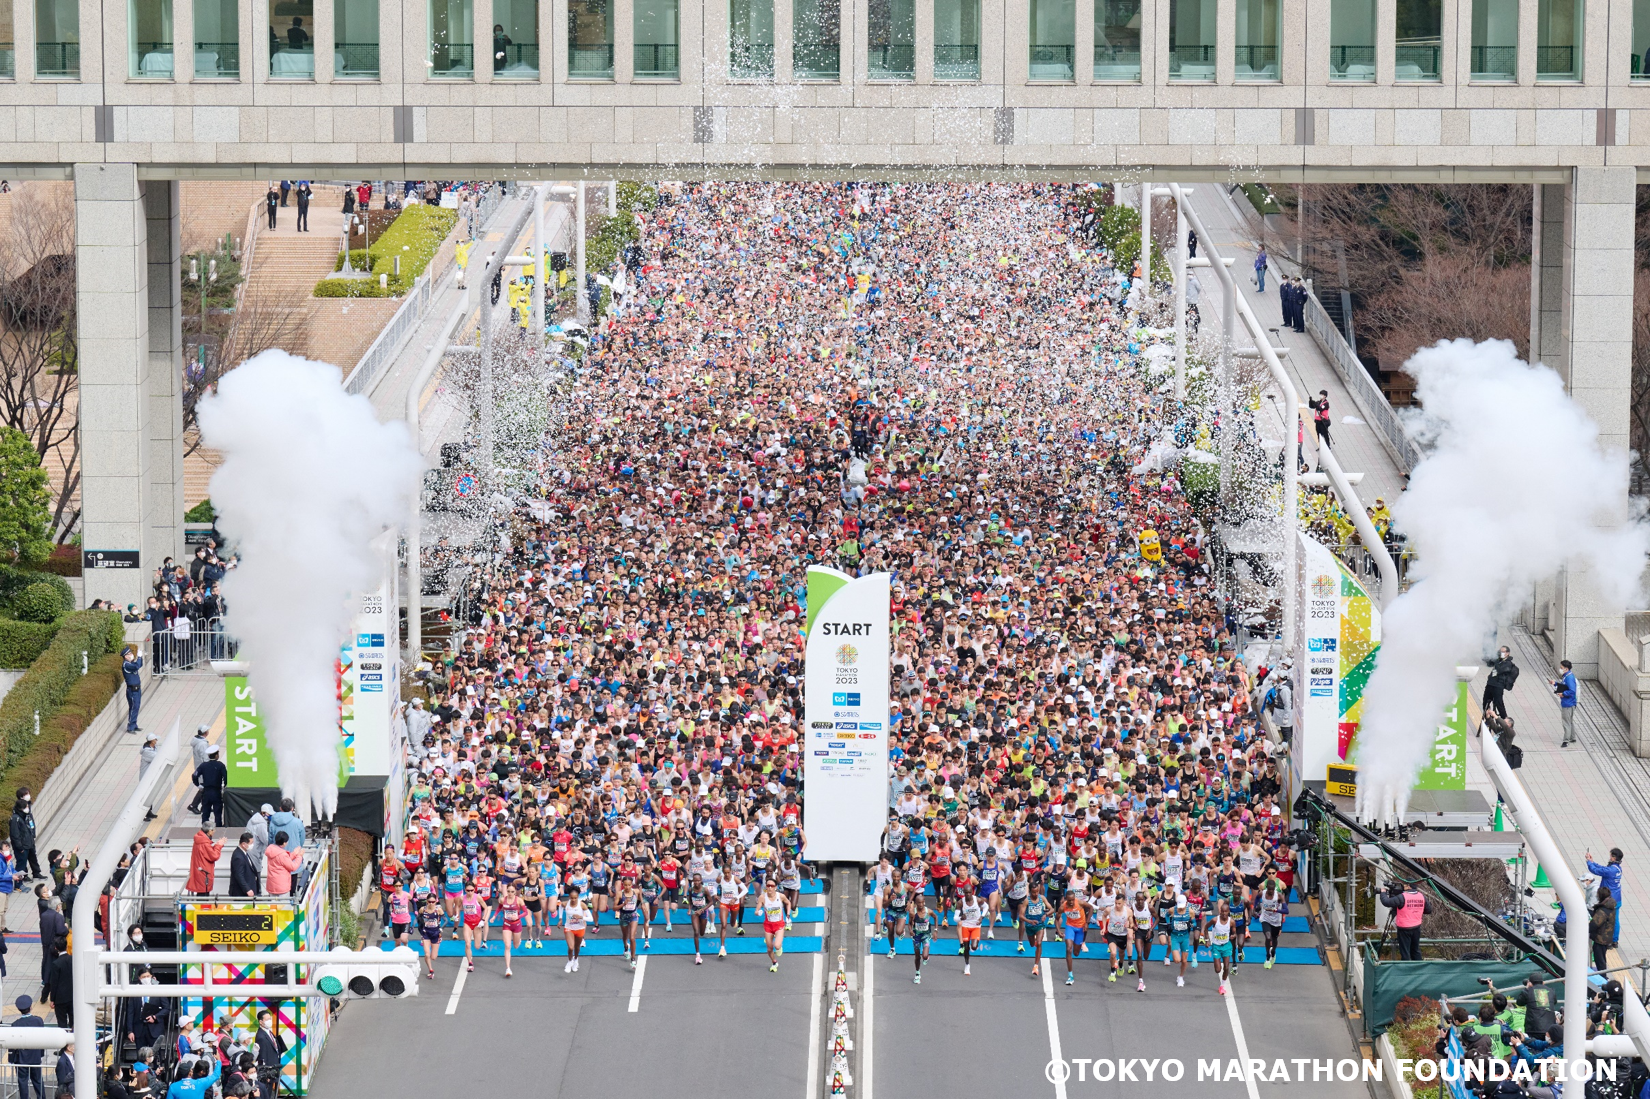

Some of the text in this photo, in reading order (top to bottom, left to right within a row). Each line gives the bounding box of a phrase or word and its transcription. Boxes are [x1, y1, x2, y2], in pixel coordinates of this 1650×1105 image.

[1311, 610, 1335, 619] 2023
[823, 623, 872, 636] START
[234, 685, 258, 772] START
[210, 932, 260, 943] SEIKO
